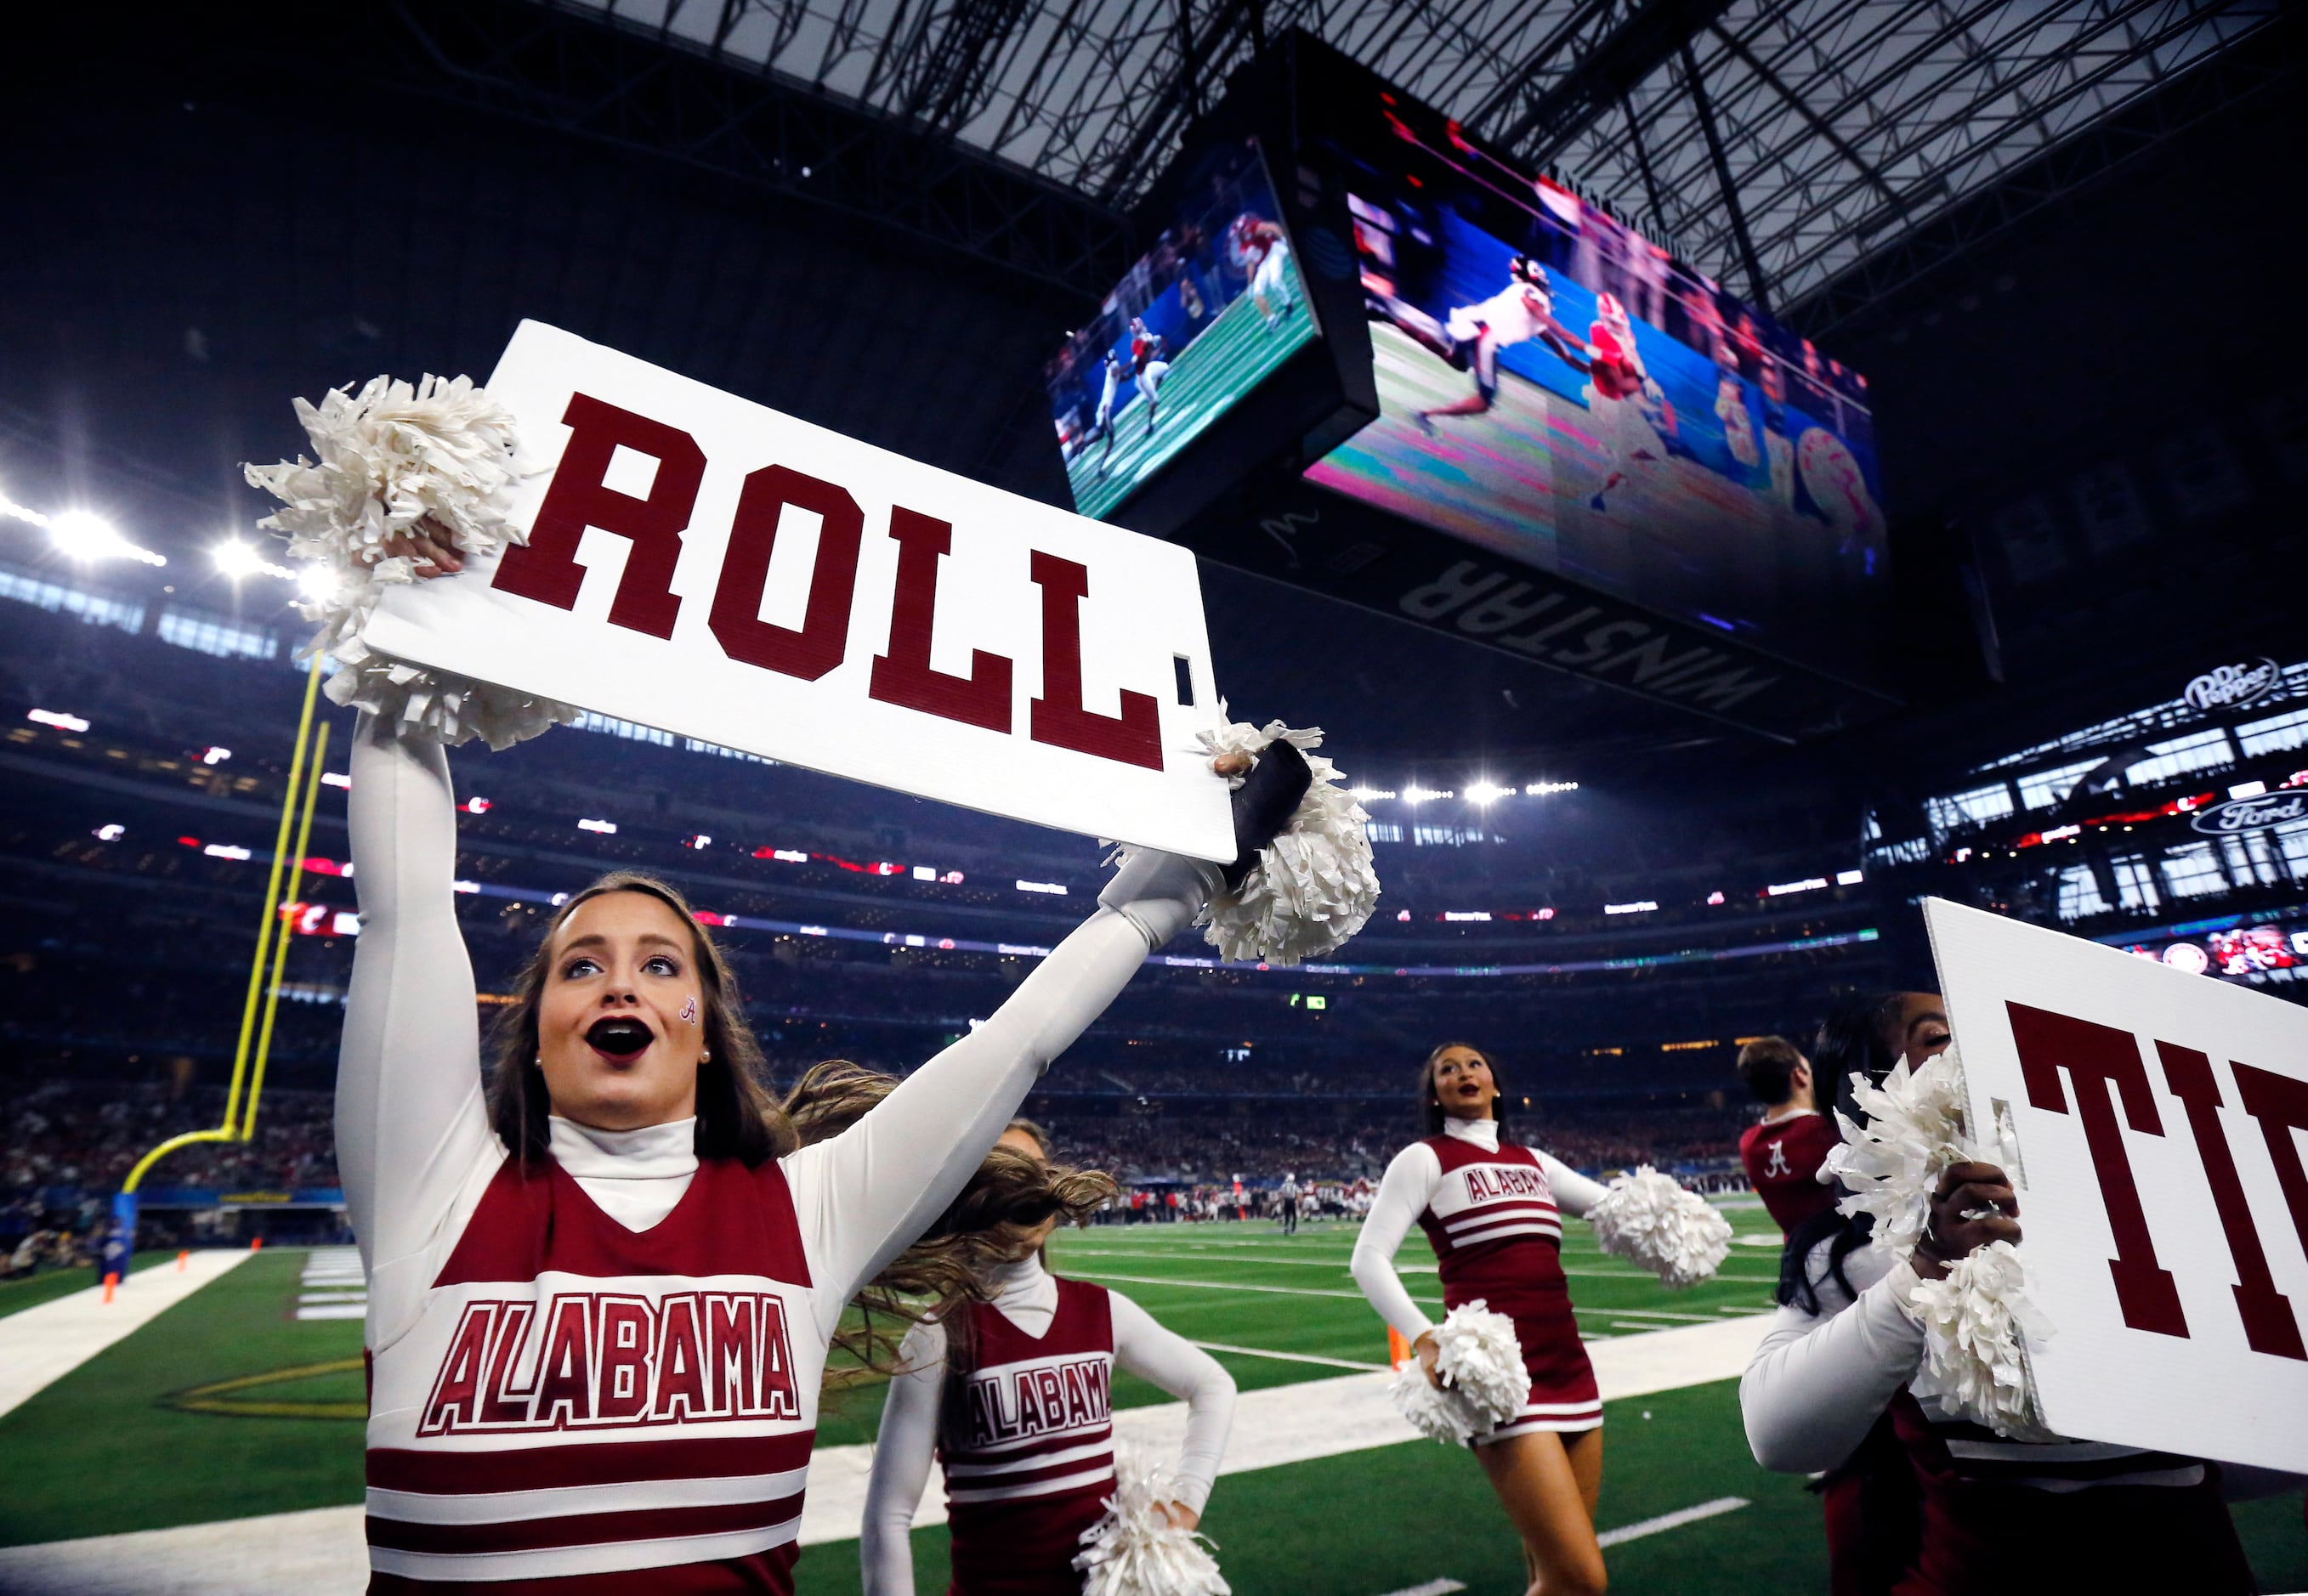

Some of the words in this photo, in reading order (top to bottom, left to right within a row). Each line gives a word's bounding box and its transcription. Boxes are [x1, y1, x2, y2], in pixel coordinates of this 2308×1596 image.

[491, 392, 1164, 771] ROLL
[1399, 560, 1779, 711] WINSTAR
[2191, 665, 2272, 710] Pepper
[2210, 663, 2248, 687] Dr
[2219, 796, 2306, 830] Ford
[1764, 1140, 1792, 1179] A
[416, 1291, 800, 1438] ALABAMA
